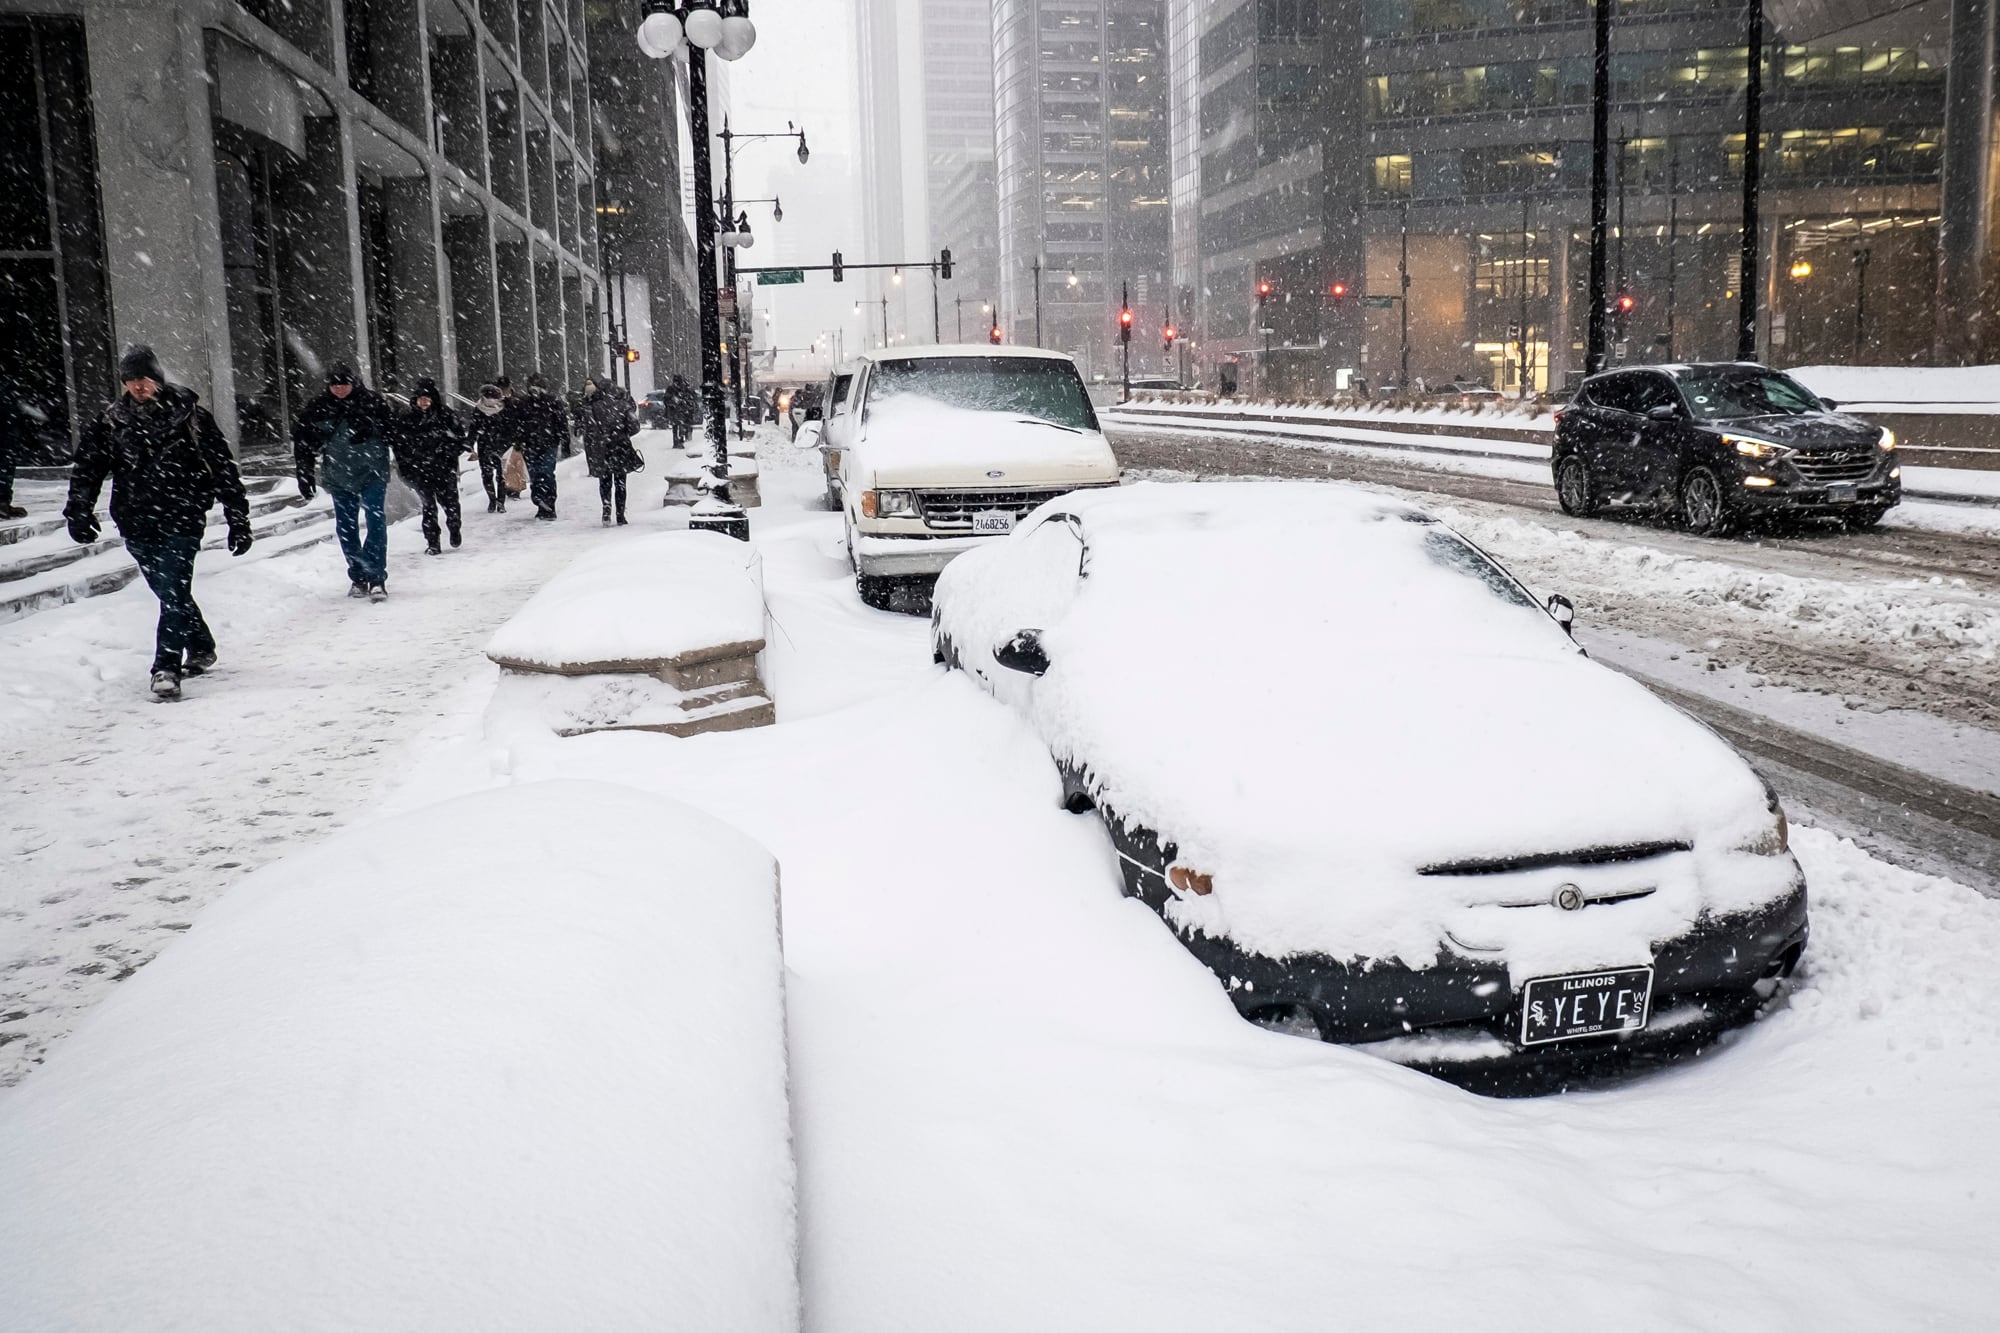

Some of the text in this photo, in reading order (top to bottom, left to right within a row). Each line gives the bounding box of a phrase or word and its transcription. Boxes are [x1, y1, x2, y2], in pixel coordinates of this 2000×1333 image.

[1563, 976, 1616, 991] ILLINOIS
[1566, 1024, 1603, 1036] WHITE SOX
